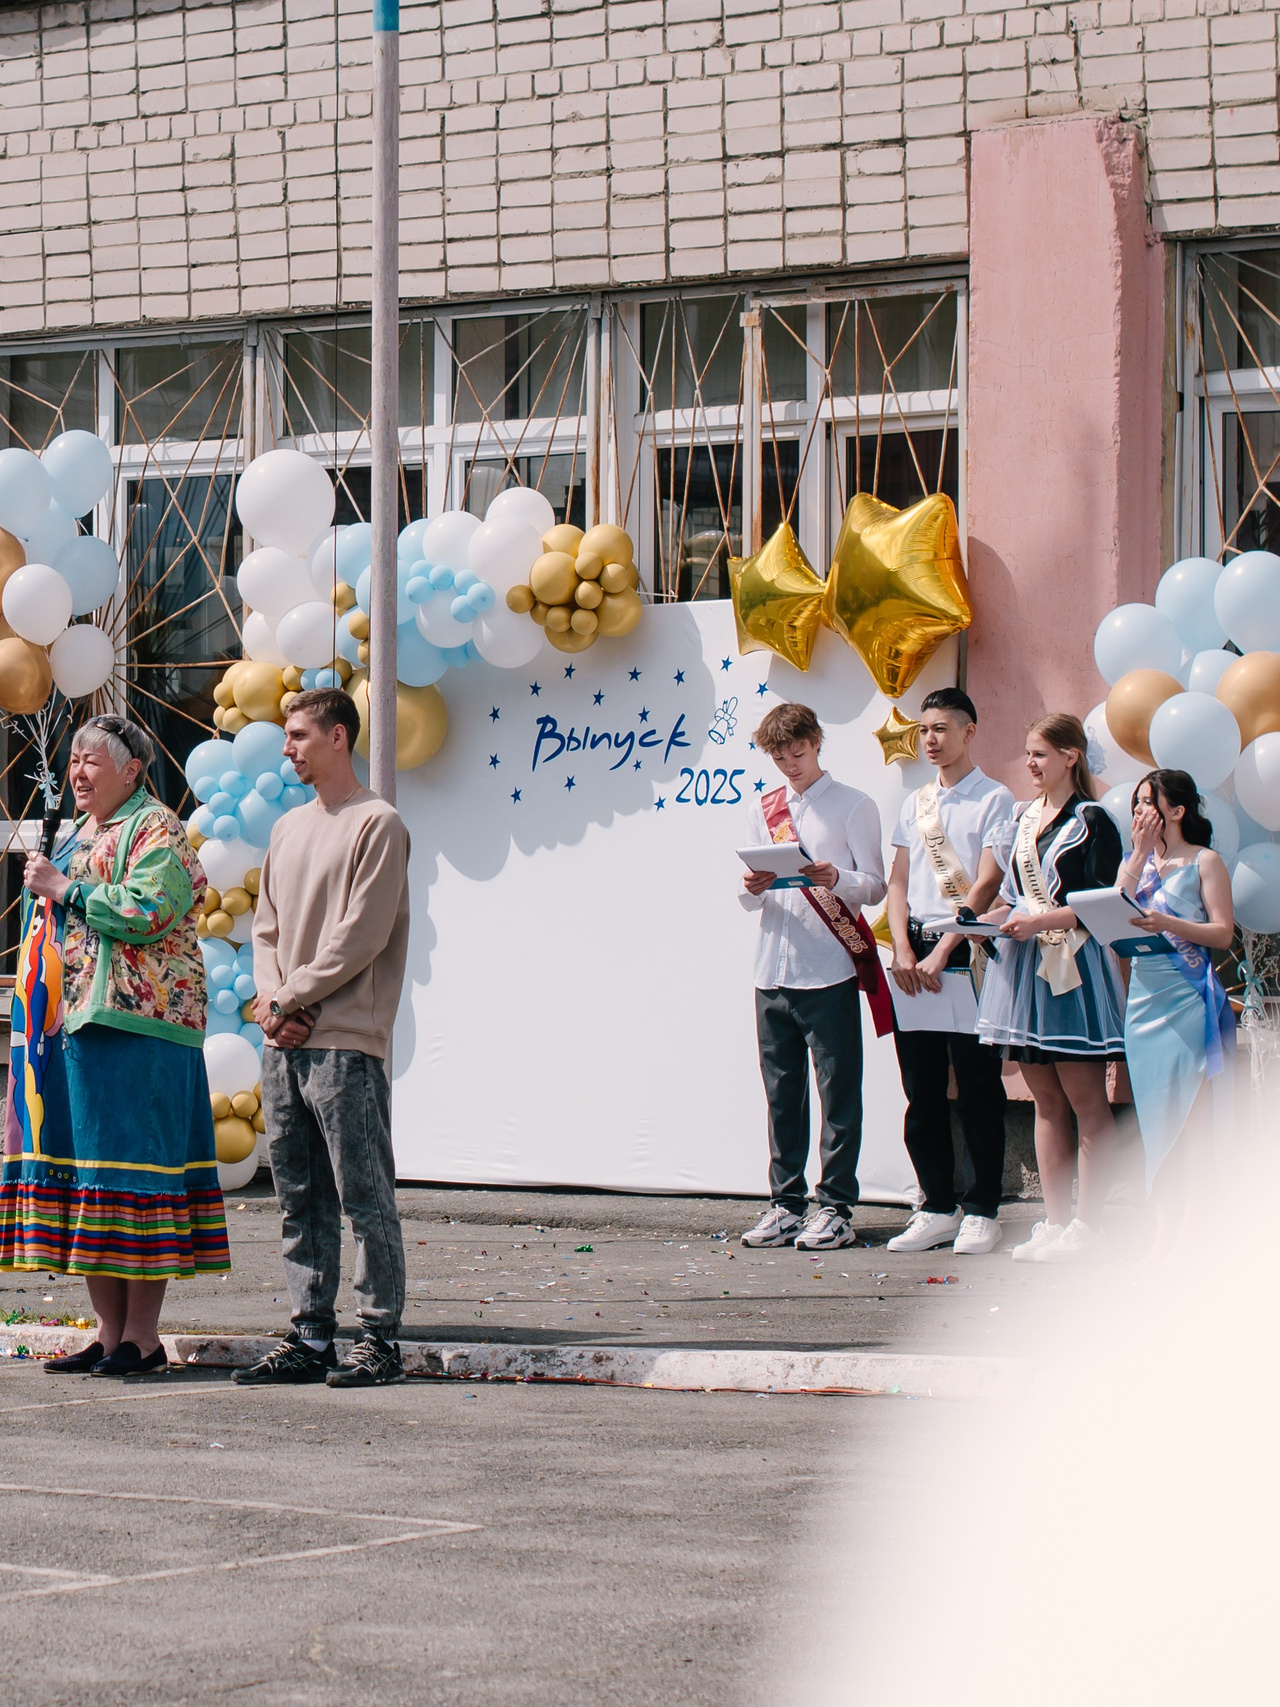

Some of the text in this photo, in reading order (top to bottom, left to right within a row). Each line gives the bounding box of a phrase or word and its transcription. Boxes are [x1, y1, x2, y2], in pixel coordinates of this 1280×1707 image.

[532, 713, 691, 772] Выпуск
[675, 767, 745, 806] 2025
[831, 916, 869, 954] 2025
[1170, 935, 1204, 968] 2025
